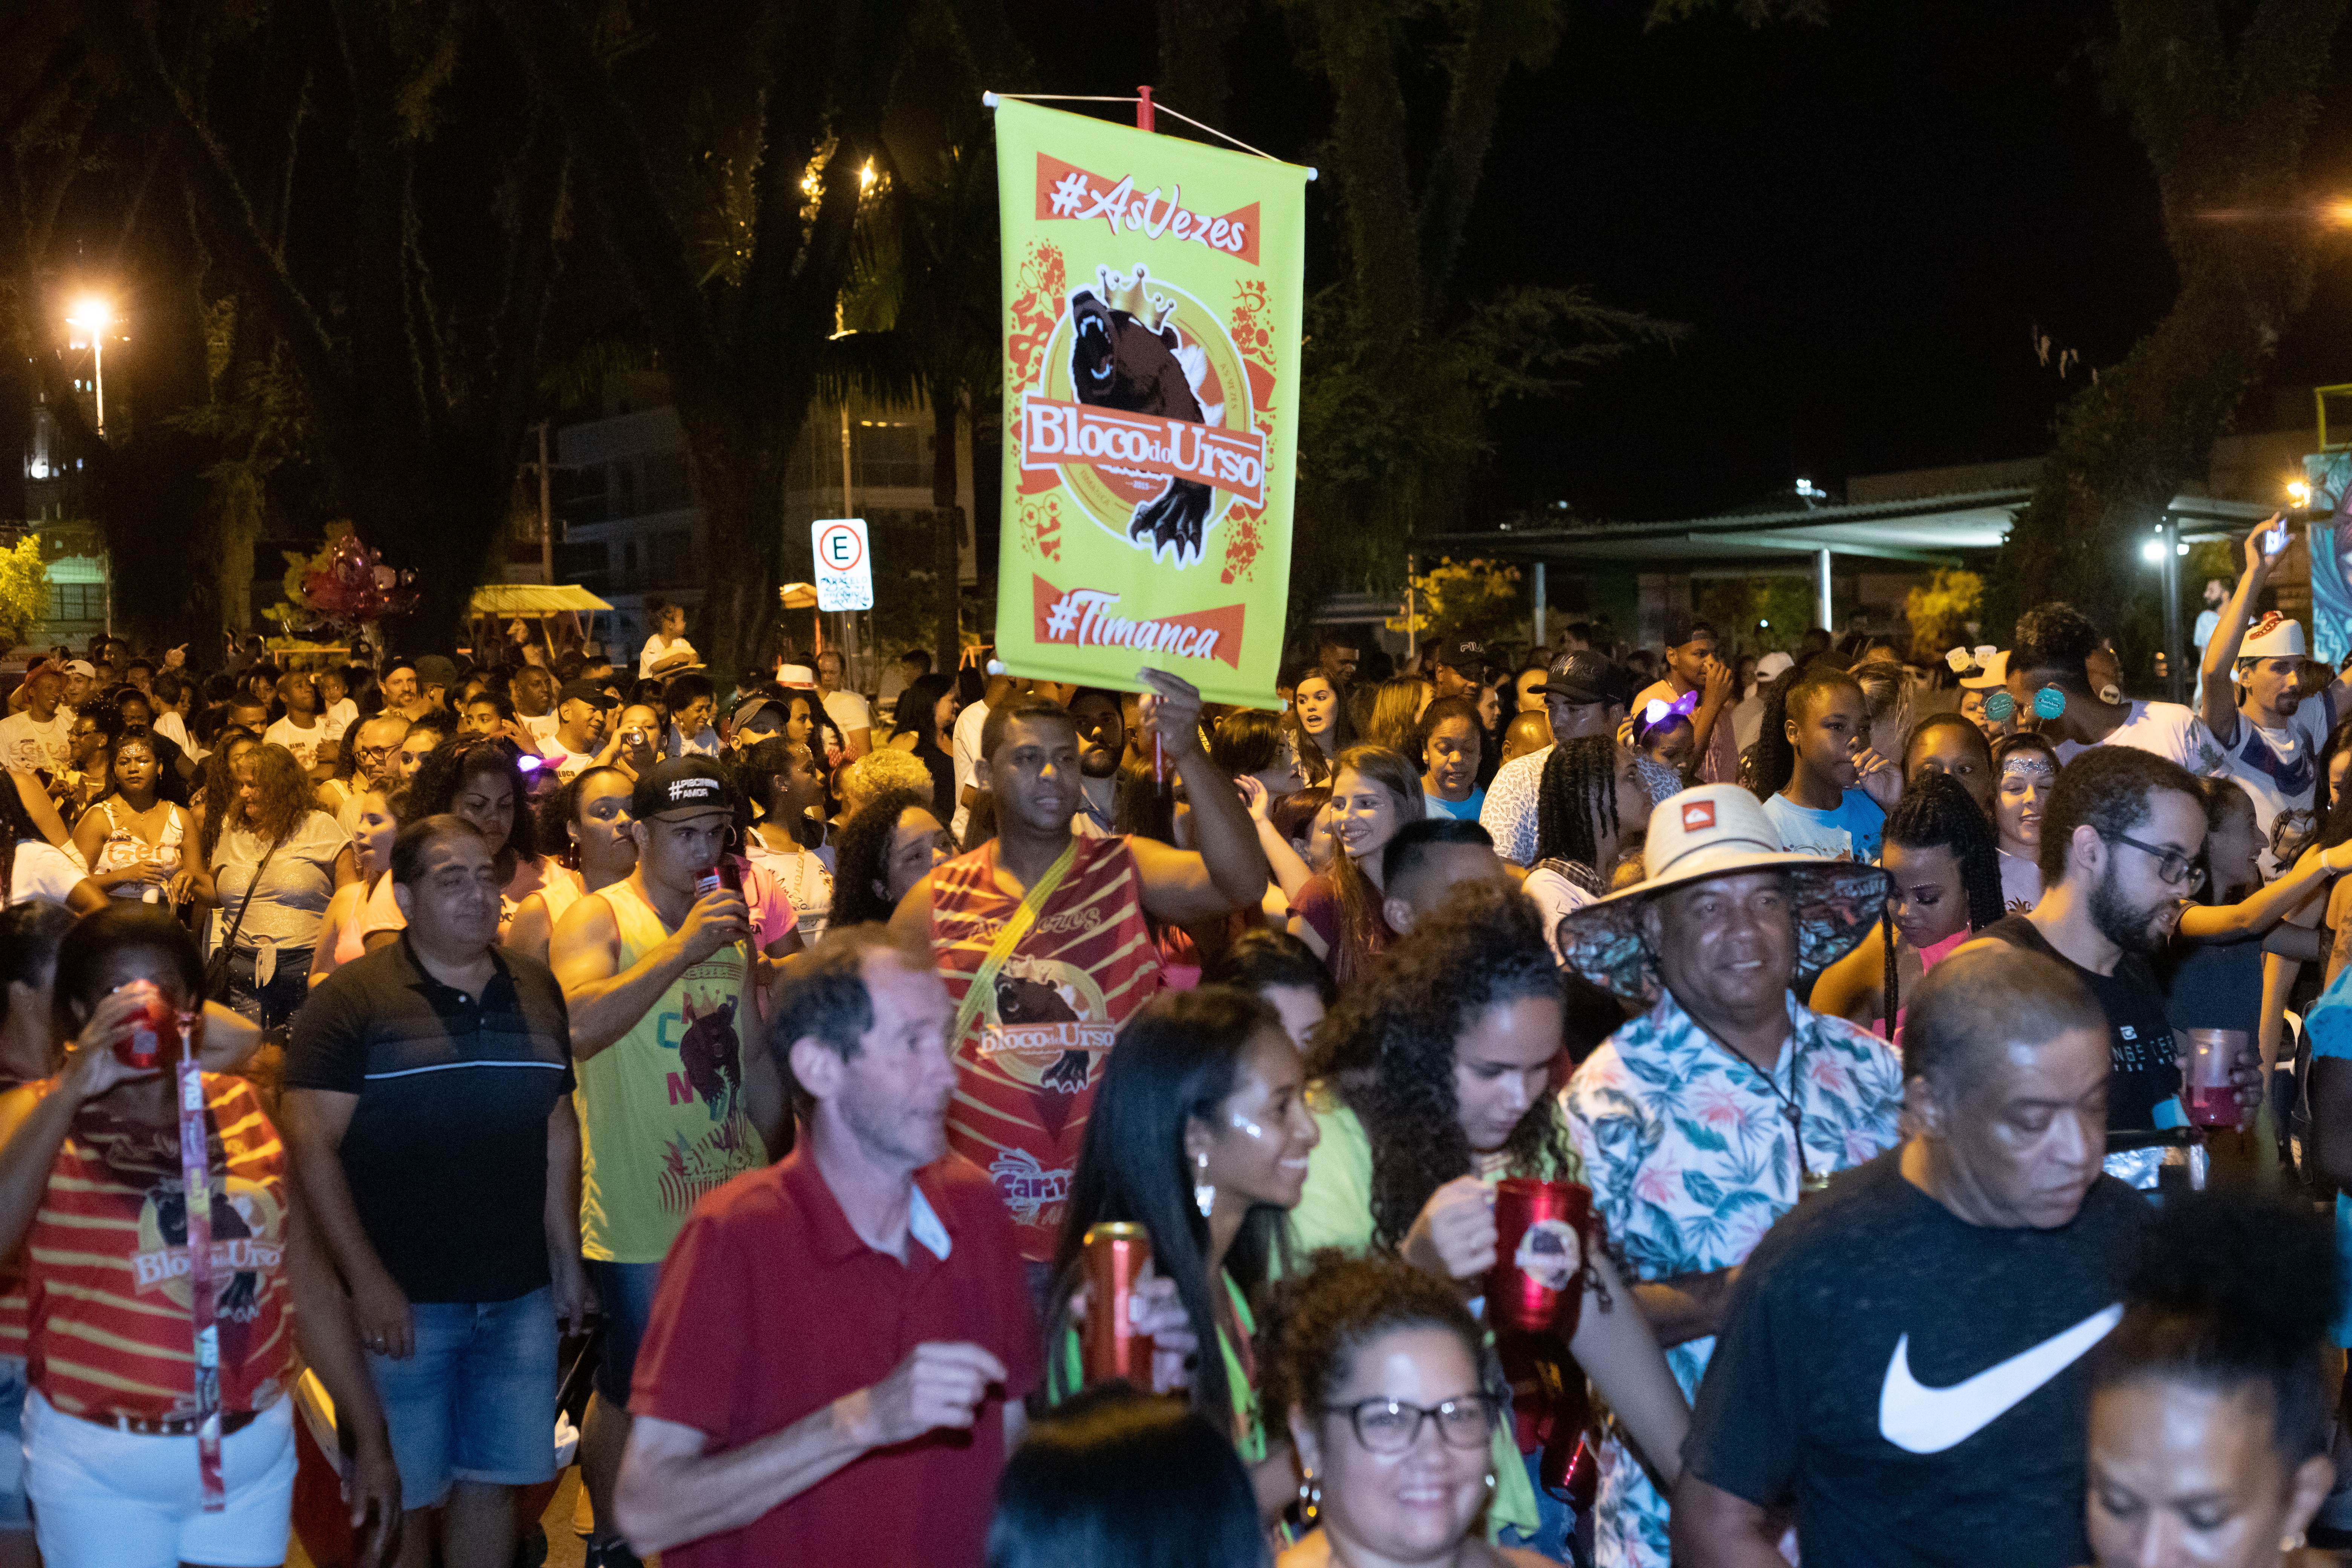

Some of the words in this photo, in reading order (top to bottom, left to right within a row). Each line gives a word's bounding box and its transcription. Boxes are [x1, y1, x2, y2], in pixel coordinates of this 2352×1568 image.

[1050, 172, 1245, 252] #AsVezes
[1027, 404, 1150, 464] Bloco
[1148, 440, 1173, 463] do
[1167, 421, 1261, 487] Urso
[833, 536, 848, 559] E
[1047, 590, 1219, 660] #Timanca
[1057, 1023, 1115, 1047] Urso
[135, 1250, 190, 1285] Blo
